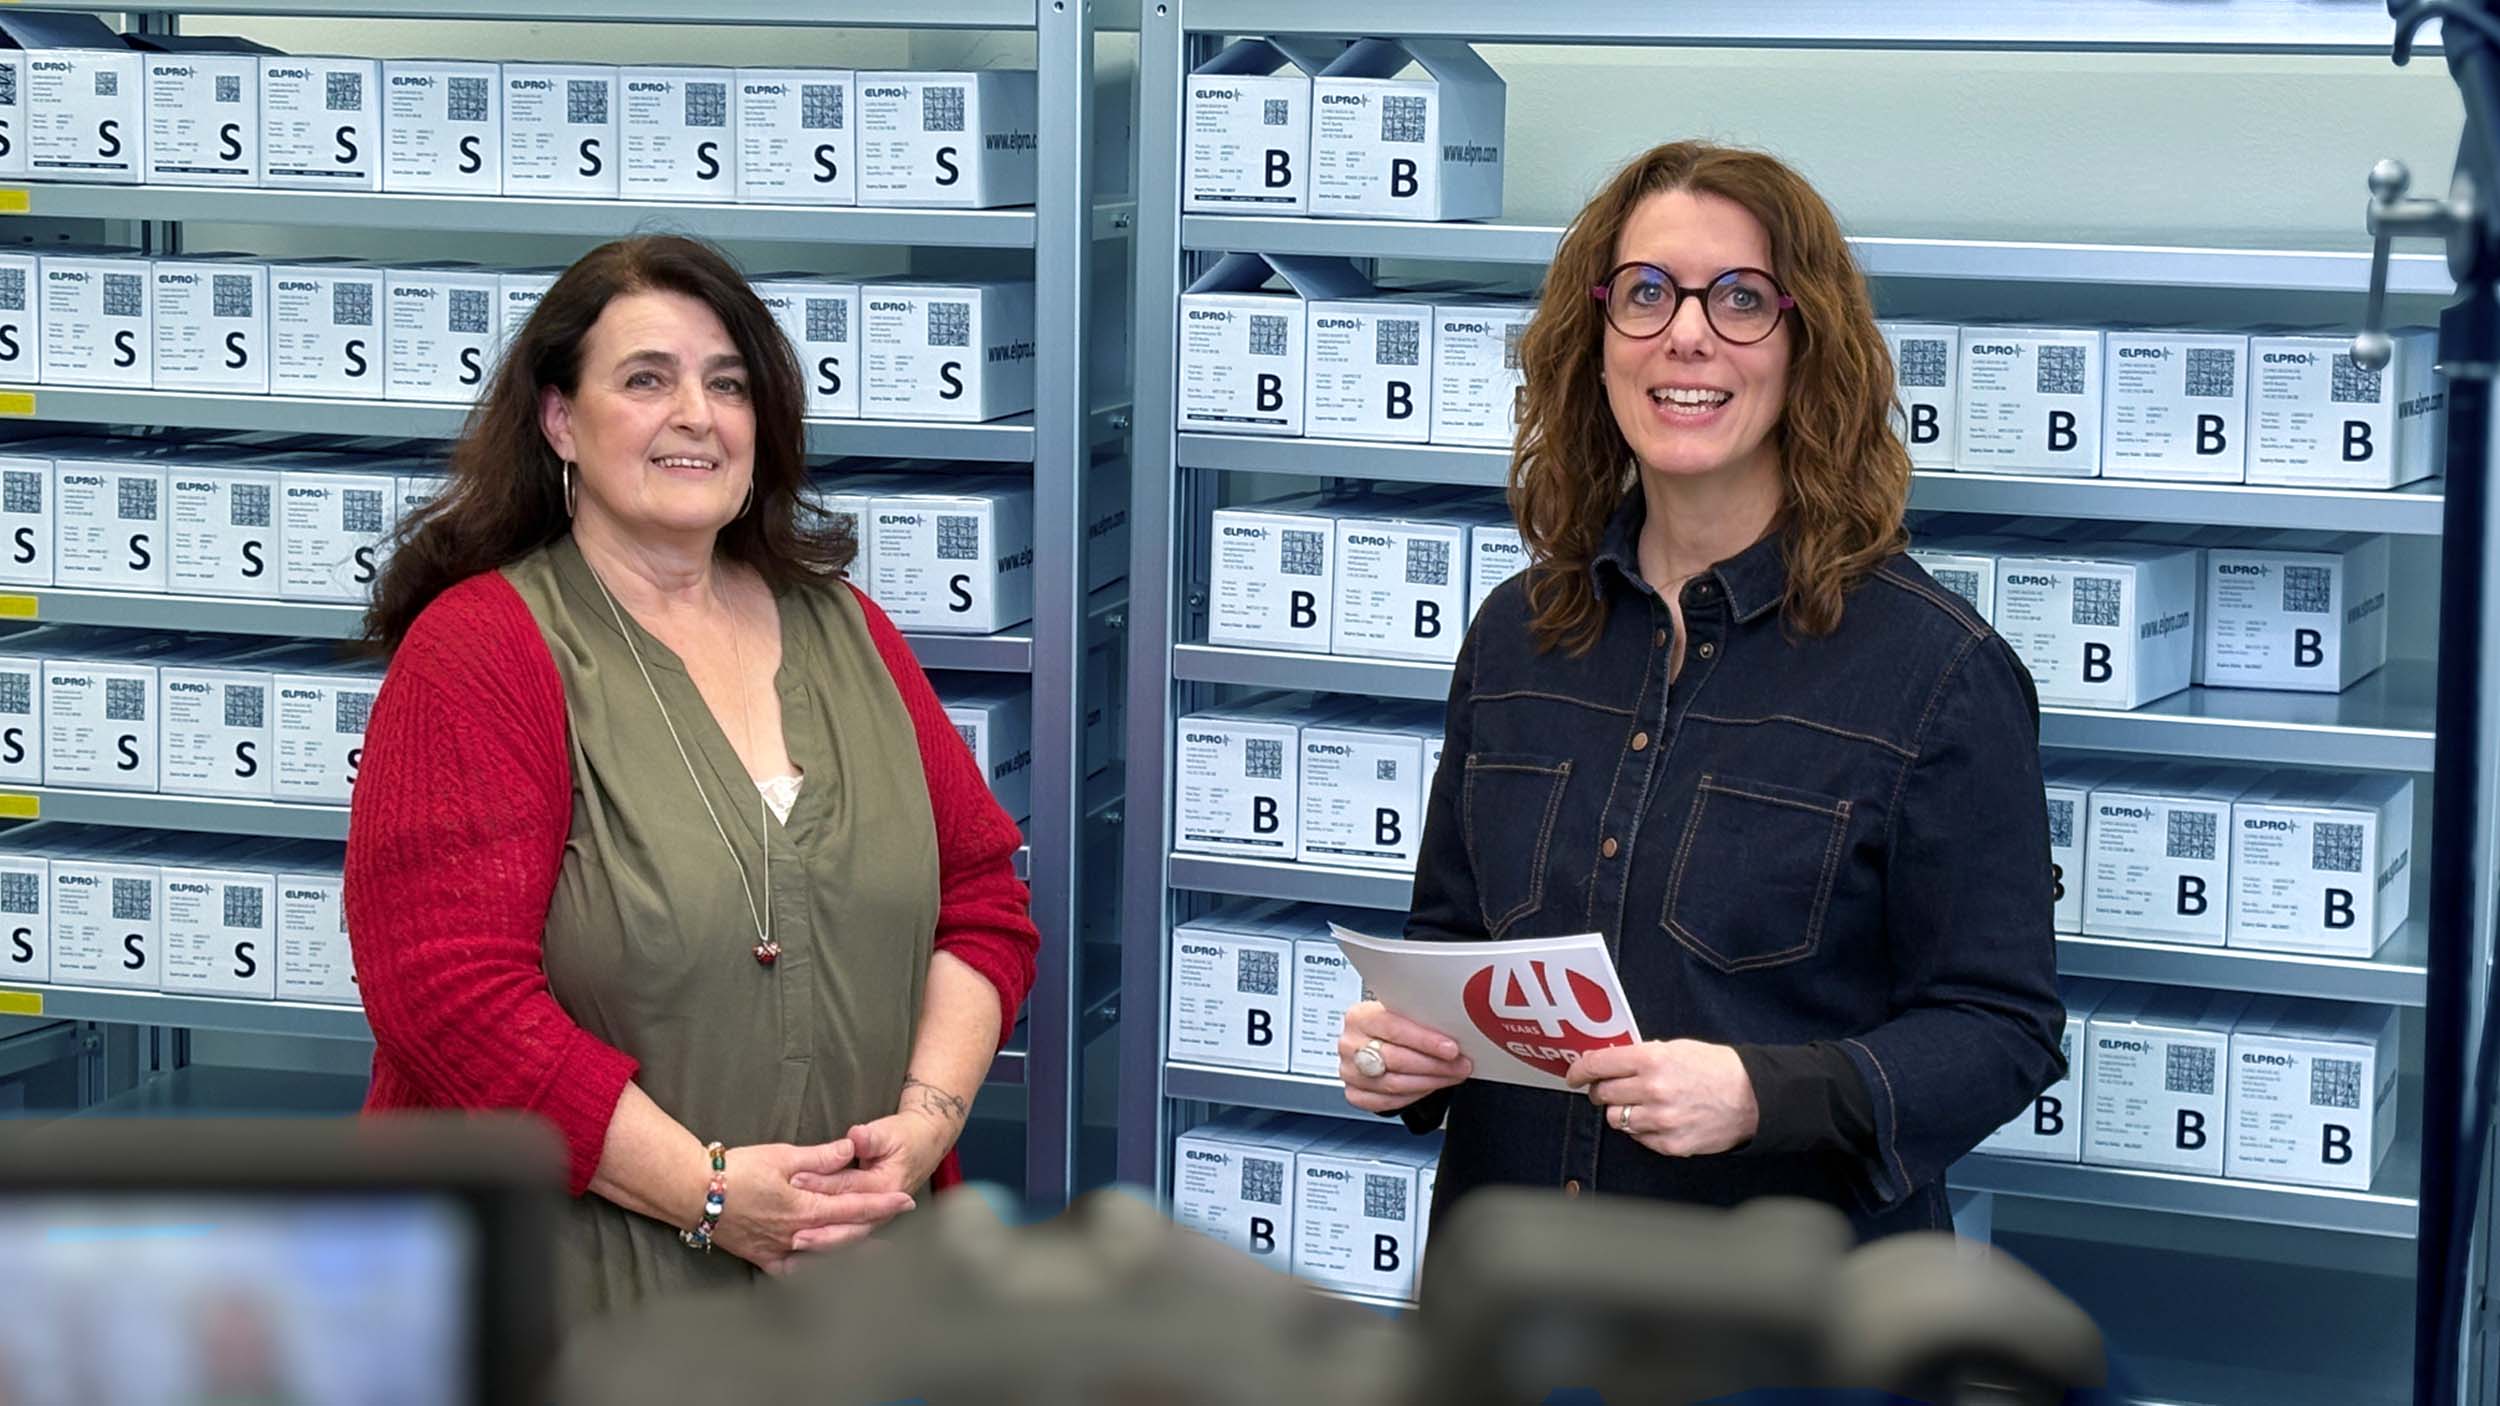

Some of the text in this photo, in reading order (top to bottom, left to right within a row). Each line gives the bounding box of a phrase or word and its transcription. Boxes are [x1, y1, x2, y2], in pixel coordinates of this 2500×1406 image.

[32, 62, 66, 72] ELPRO
[153, 67, 189, 78] ELPRO
[268, 69, 303, 80] ELPRO
[392, 77, 427, 88] ELPRO
[511, 80, 546, 91] ELPRO
[629, 82, 664, 93] ELPRO
[744, 84, 780, 96] ELPRO
[865, 87, 901, 99] ELPRO
[1196, 89, 1234, 101] ELPRO
[1322, 95, 1360, 106] ELPRO
[99, 120, 120, 157] S
[220, 124, 241, 161] S
[336, 126, 357, 163] S
[985, 128, 1037, 155] www.elpro.c
[460, 136, 481, 173] S
[580, 139, 601, 176] S
[697, 142, 719, 179] S
[814, 145, 836, 182] S
[936, 147, 958, 185] S
[1443, 139, 1497, 167] www.elpro.com
[1266, 150, 1291, 187] B
[1392, 159, 1418, 197] B
[49, 272, 83, 283] ELPRO
[159, 274, 192, 285] ELPRO
[279, 282, 314, 293] ELPRO
[394, 288, 429, 299] ELPRO
[509, 291, 544, 301] ELPRO
[762, 299, 785, 308] PRO
[870, 302, 906, 313] ELPRO
[1189, 311, 1226, 322] ELPRO
[1317, 319, 1354, 330] ELPRO
[1444, 322, 1482, 335] ELPRO
[0, 325, 19, 361] S
[114, 331, 135, 367] S
[226, 332, 247, 368] S
[988, 339, 1035, 364] www.elpro.c
[1972, 344, 2013, 357] ELPRO
[2119, 347, 2161, 360] ELPRO
[345, 340, 366, 377] S
[460, 348, 481, 384] S
[2263, 353, 2307, 366] ELPRO
[818, 357, 840, 394] S
[940, 362, 962, 399] S
[1257, 374, 1283, 411] B
[1387, 381, 1412, 419] B
[1911, 404, 1939, 443] B
[2048, 411, 2077, 451] B
[2197, 415, 2226, 454] B
[2343, 421, 2373, 461] B
[64, 476, 97, 487] ELPRO
[176, 482, 210, 493] ELPRO
[288, 489, 322, 499] ELPRO
[879, 515, 916, 526] ELPRO
[1224, 527, 1260, 540] ELPRO
[15, 528, 35, 563] S
[129, 535, 150, 570] S
[1348, 536, 1386, 548] ELPRO
[1481, 543, 1519, 554] ELPRO
[242, 541, 263, 577] S
[355, 547, 376, 583] S
[998, 545, 1033, 573] www.elp
[2219, 565, 2260, 577] ELPRO
[950, 575, 972, 612] S
[2008, 575, 2048, 588] ELPRO
[1291, 591, 1316, 628] B
[1415, 600, 1440, 638] B
[2140, 611, 2190, 640] www.elpro.com
[2295, 629, 2323, 667] B
[2084, 643, 2112, 682] B
[52, 677, 86, 688] ELPRO
[170, 683, 204, 694] ELPRO
[282, 690, 316, 701] ELPRO
[3, 728, 24, 763] S
[118, 735, 138, 770] S
[1186, 734, 1222, 746] ELPRO
[1308, 744, 1344, 757] ELPRO
[236, 742, 257, 777] S
[1254, 796, 1278, 833] B
[1376, 808, 1401, 845] B
[2100, 807, 2142, 820] ELPRO
[2244, 820, 2287, 833] ELPRO
[59, 876, 92, 887] ELPRO
[170, 884, 203, 894] ELPRO
[2178, 875, 2207, 915] B
[285, 890, 319, 901] ELPRO
[2325, 888, 2354, 929] B
[12, 928, 33, 963] S
[124, 934, 145, 969] S
[1182, 945, 1217, 958] ELPRO
[235, 942, 255, 977] S
[1304, 955, 1340, 968] ELPRO
[1489, 957, 1628, 1038] 40
[1248, 1009, 1272, 1046] B
[1502, 1022, 1541, 1036] YEARS
[1506, 1041, 1582, 1064] ELPR
[2099, 1039, 2142, 1054] ELPRO
[2242, 1054, 2286, 1067] ELPRO
[2035, 1096, 2063, 1136] B
[2177, 1110, 2206, 1149] B
[2322, 1124, 2352, 1164] B
[1186, 1151, 1223, 1165] ELPRO
[1307, 1168, 1345, 1182] ELPRO
[1250, 1216, 1275, 1255] B
[1374, 1234, 1399, 1271] B
